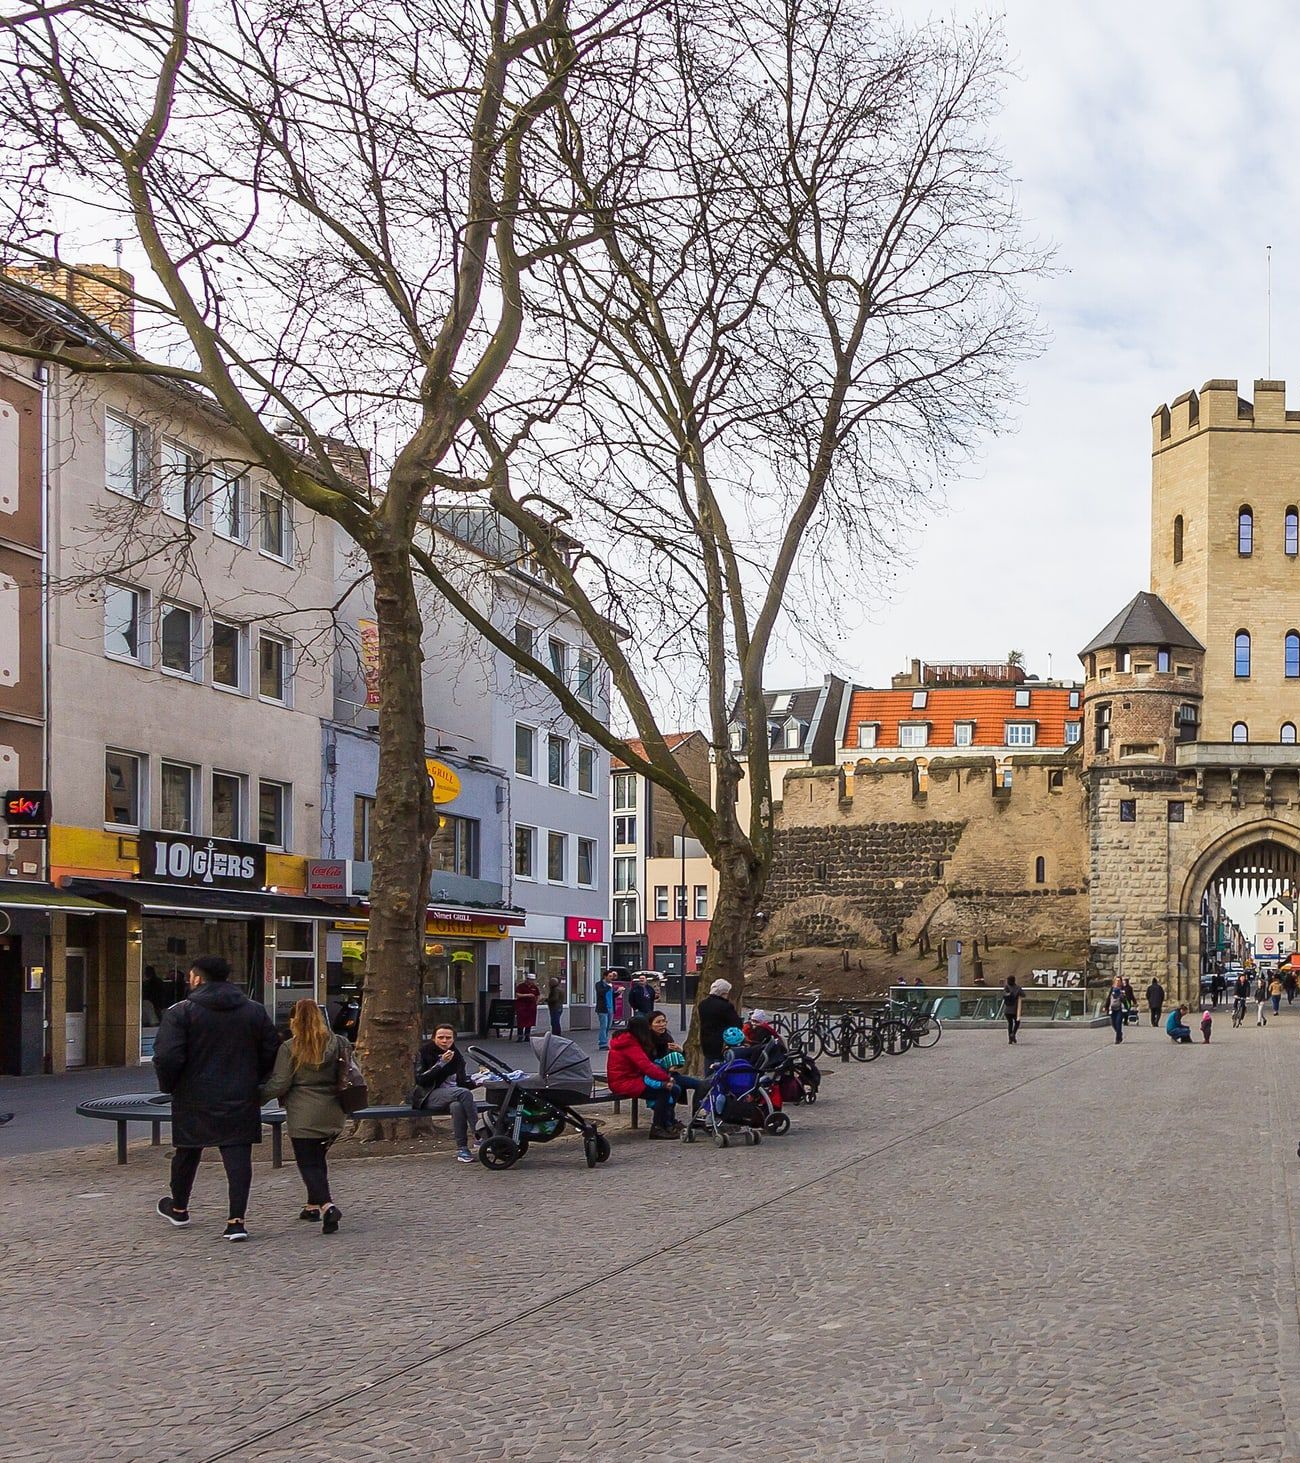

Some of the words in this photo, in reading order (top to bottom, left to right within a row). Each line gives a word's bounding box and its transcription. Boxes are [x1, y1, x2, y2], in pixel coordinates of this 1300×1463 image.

[9, 798, 40, 817] sky
[434, 912, 452, 920] Nimet
[453, 913, 472, 921] GRILL
